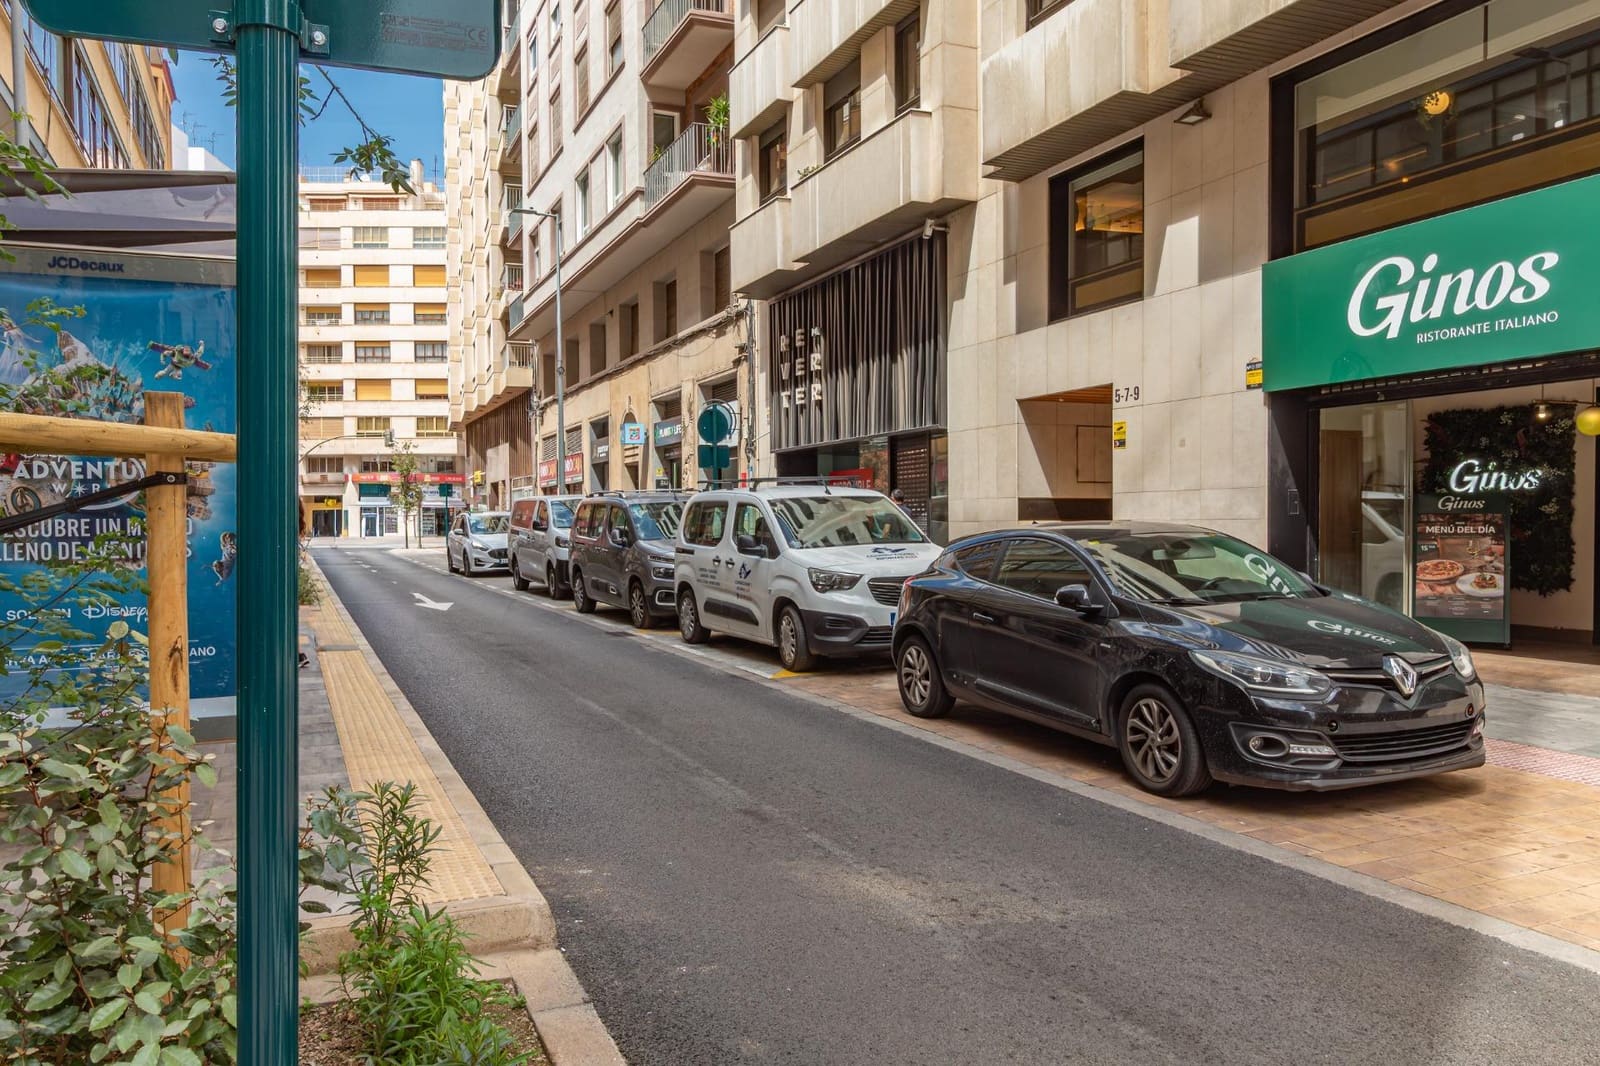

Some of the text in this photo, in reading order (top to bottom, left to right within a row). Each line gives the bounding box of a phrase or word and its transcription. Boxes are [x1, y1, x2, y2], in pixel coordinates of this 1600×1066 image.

[47, 255, 125, 273] JCDecaux
[1347, 251, 1560, 339] Ginos
[1416, 311, 1559, 344] RISTORANTE ITALIANO
[1114, 386, 1140, 403] 5-7-9
[13, 461, 147, 480] ADVENTU
[1450, 459, 1543, 493] Ginos
[1438, 495, 1486, 511] Ginos
[3, 518, 91, 538] SCUBRE
[1425, 524, 1496, 534] MENÚ DEL DÍA
[0, 542, 52, 561] LENO
[58, 542, 82, 560] DE
